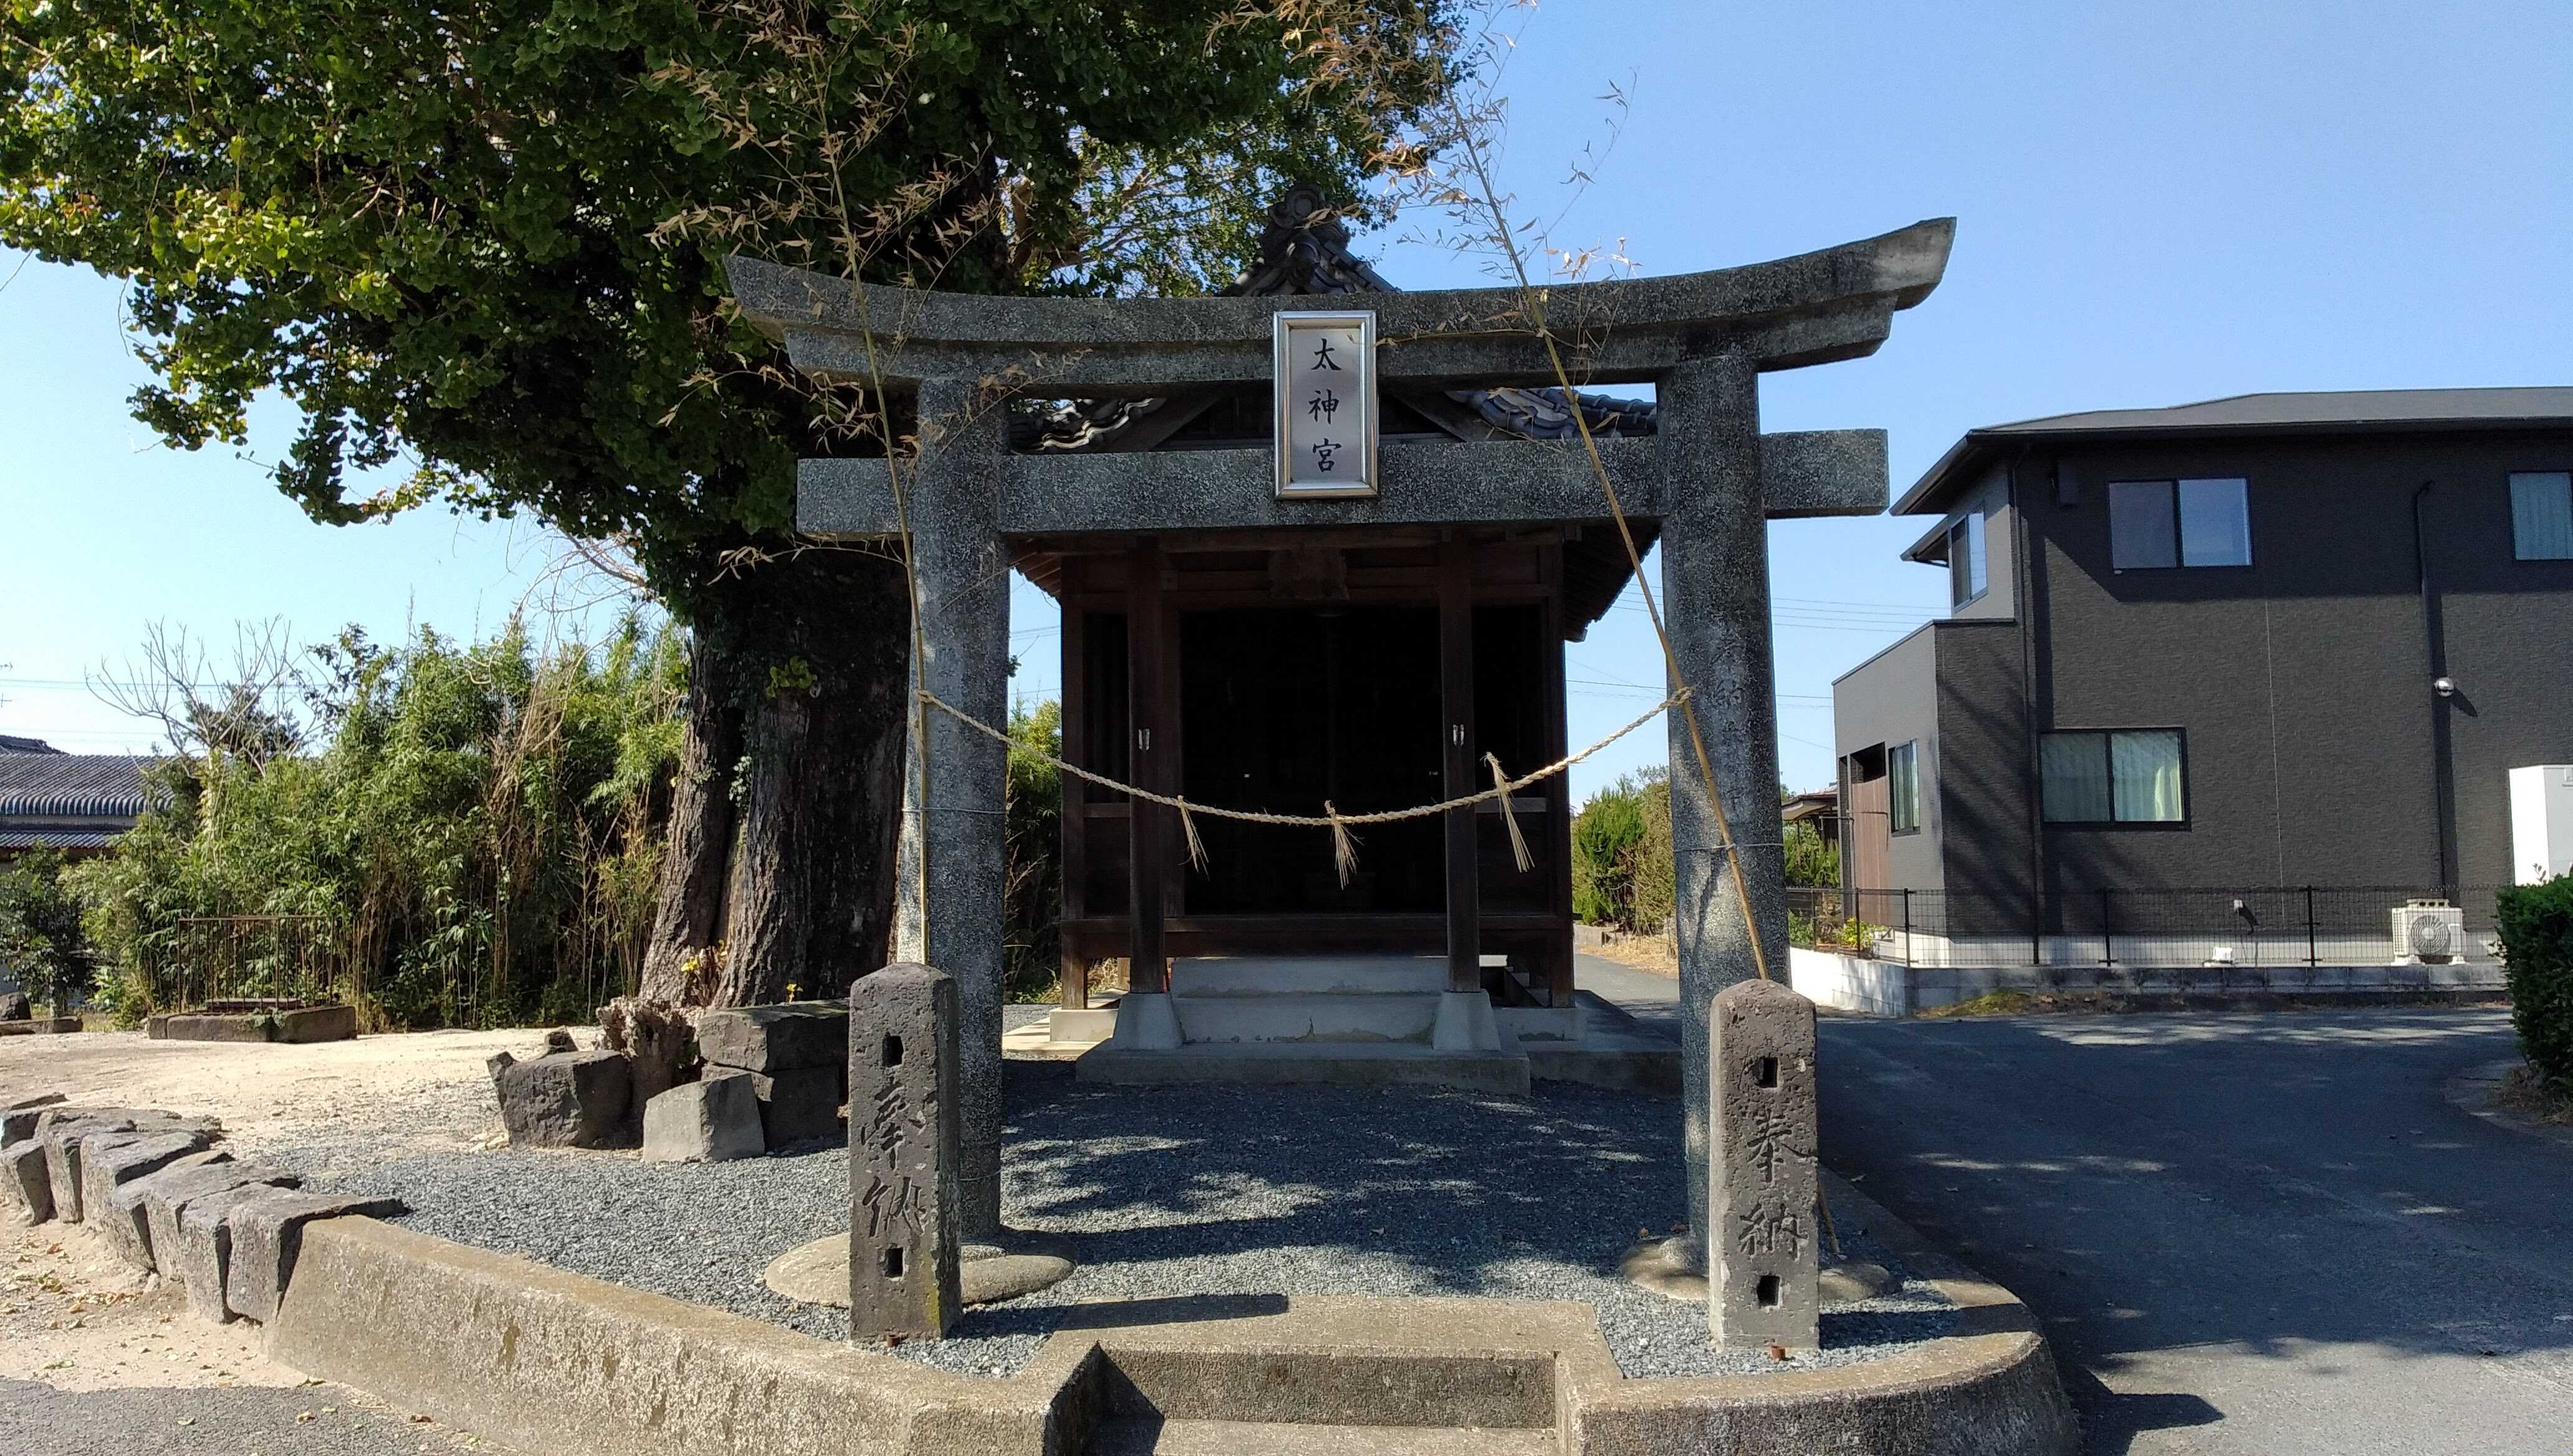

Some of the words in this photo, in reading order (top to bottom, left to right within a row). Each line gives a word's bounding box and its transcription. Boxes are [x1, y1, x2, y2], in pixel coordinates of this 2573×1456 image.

[1308, 337, 1343, 473] 太神宮
[1738, 1109, 1816, 1260] 奉納
